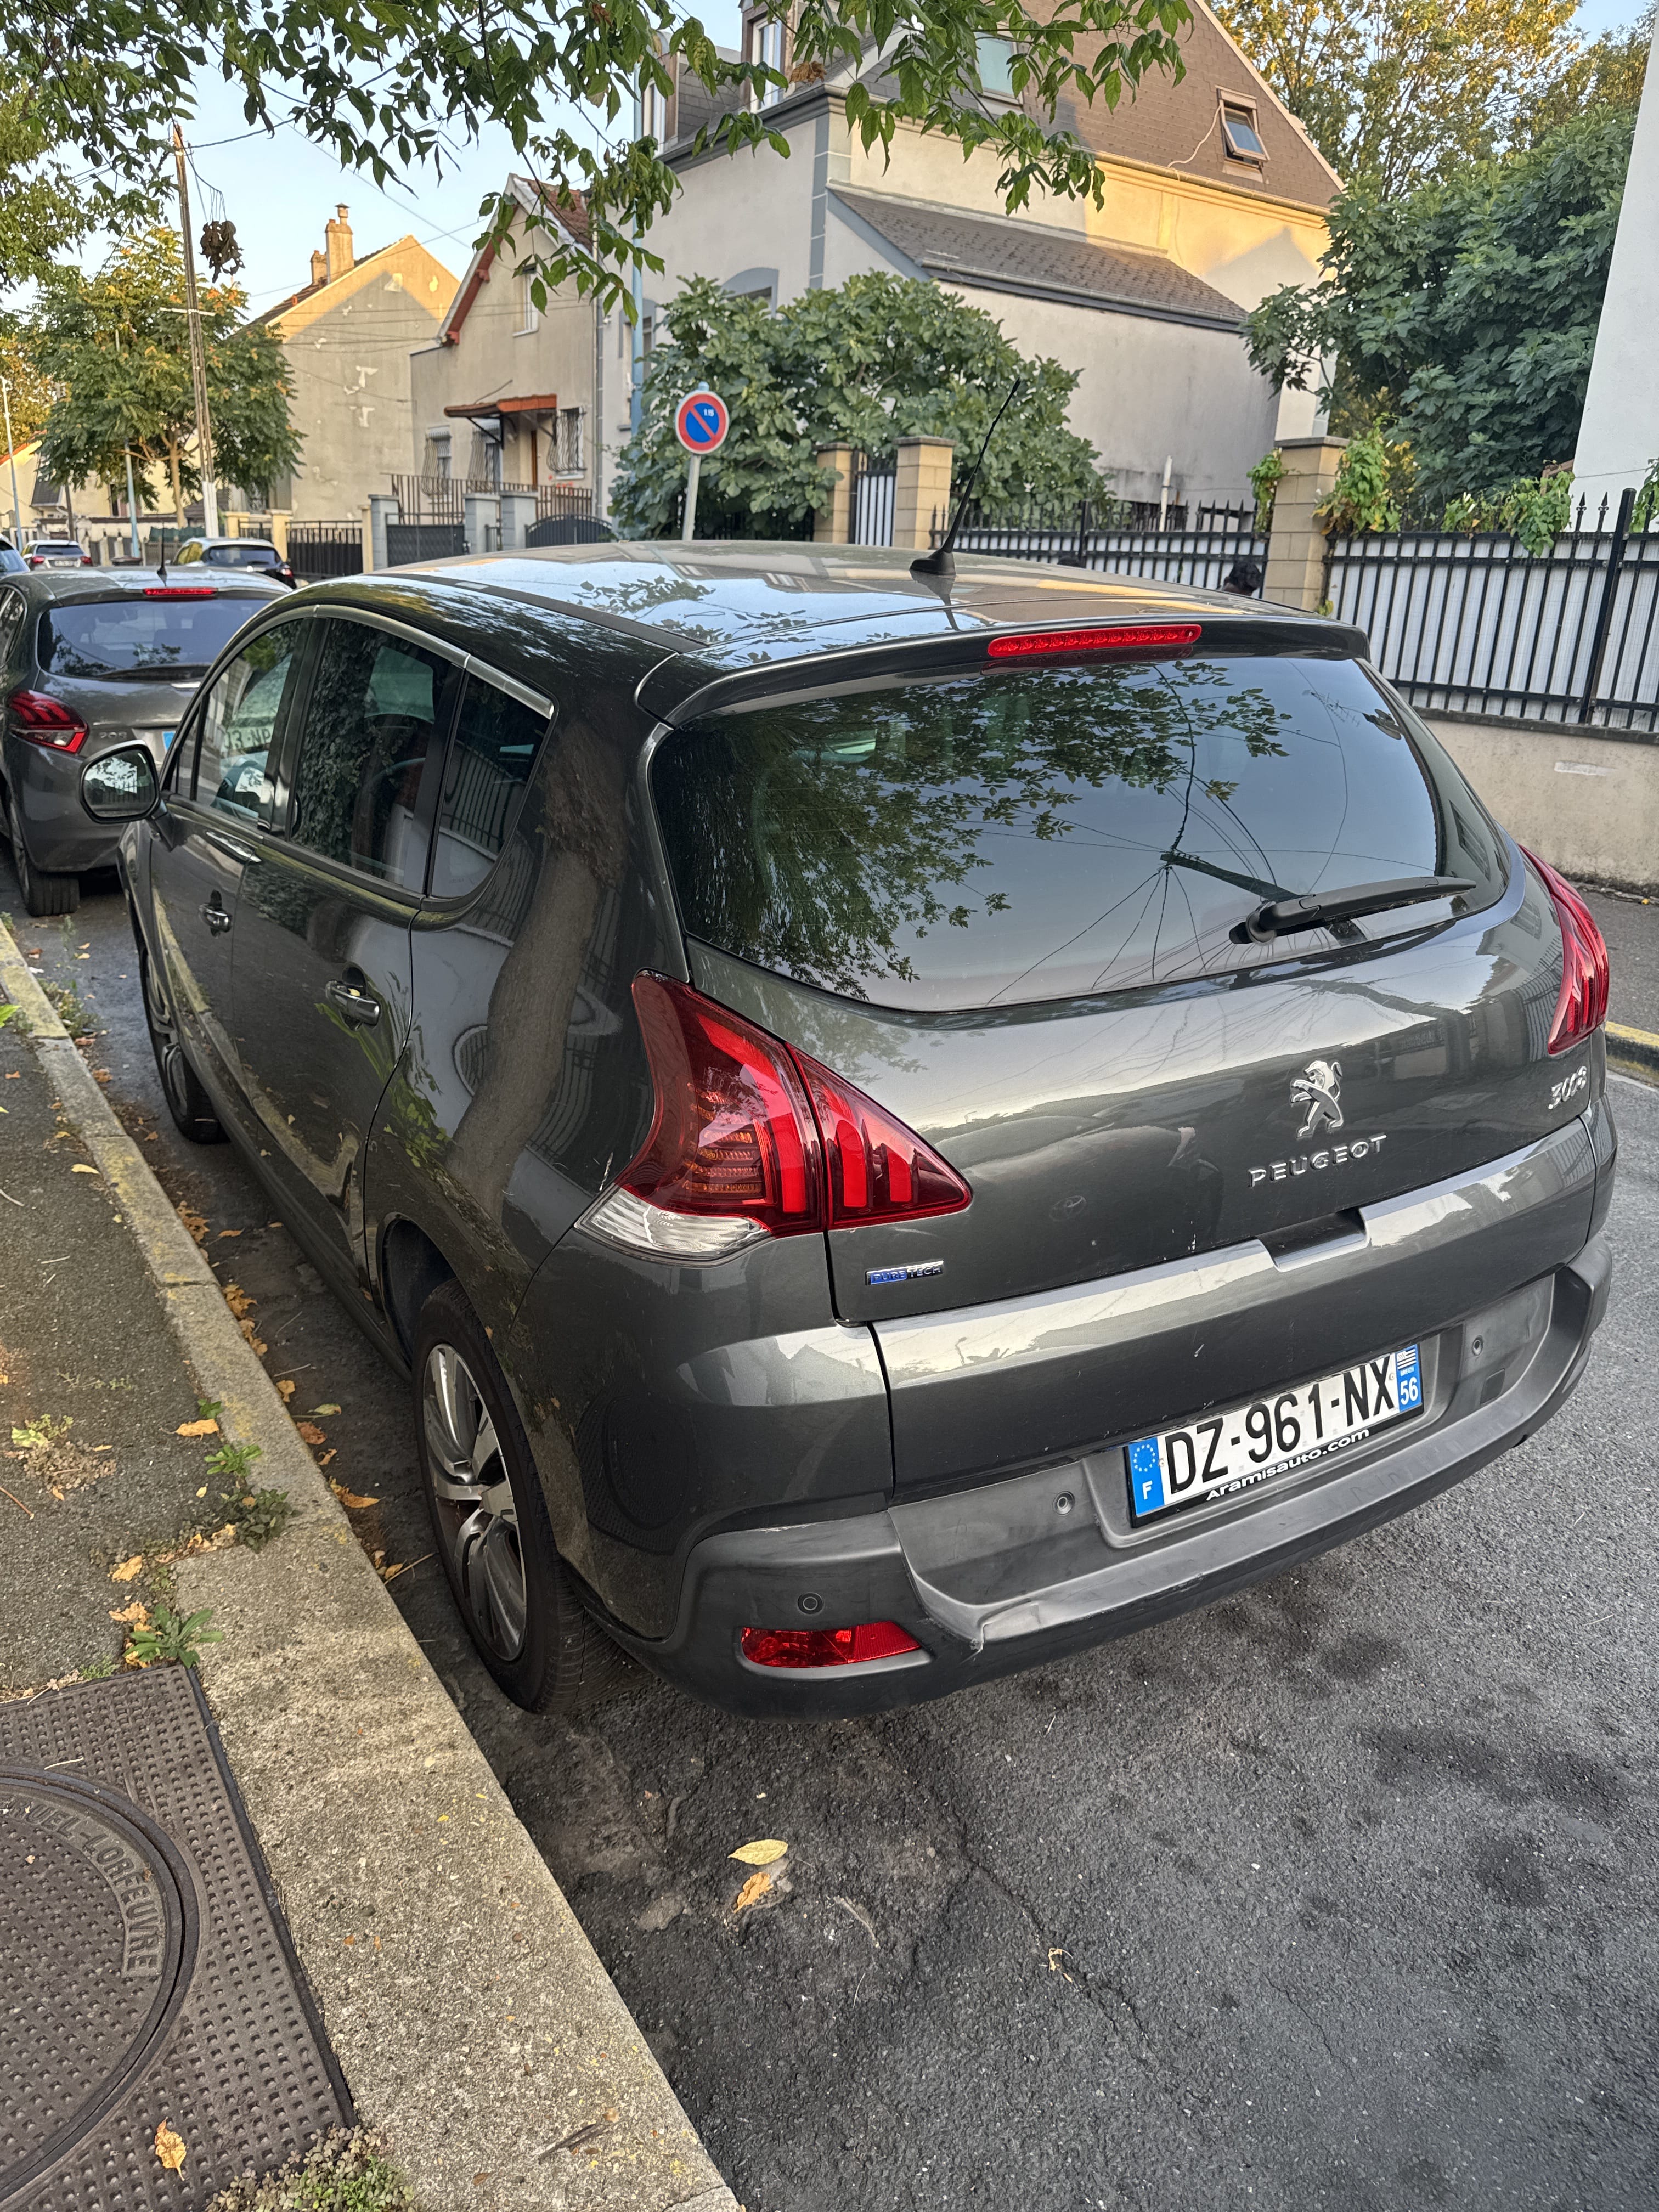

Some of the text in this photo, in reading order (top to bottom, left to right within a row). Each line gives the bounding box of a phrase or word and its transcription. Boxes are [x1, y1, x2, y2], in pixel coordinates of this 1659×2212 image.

[1548, 1066, 1587, 1109] 3008
[1247, 1133, 1387, 1188] PEUGEOT
[1400, 1376, 1418, 1405] 56
[1165, 1355, 1395, 1495] DZ-961-NX
[1206, 1428, 1369, 1501] Aramisauto.com
[1142, 1480, 1153, 1500] F
